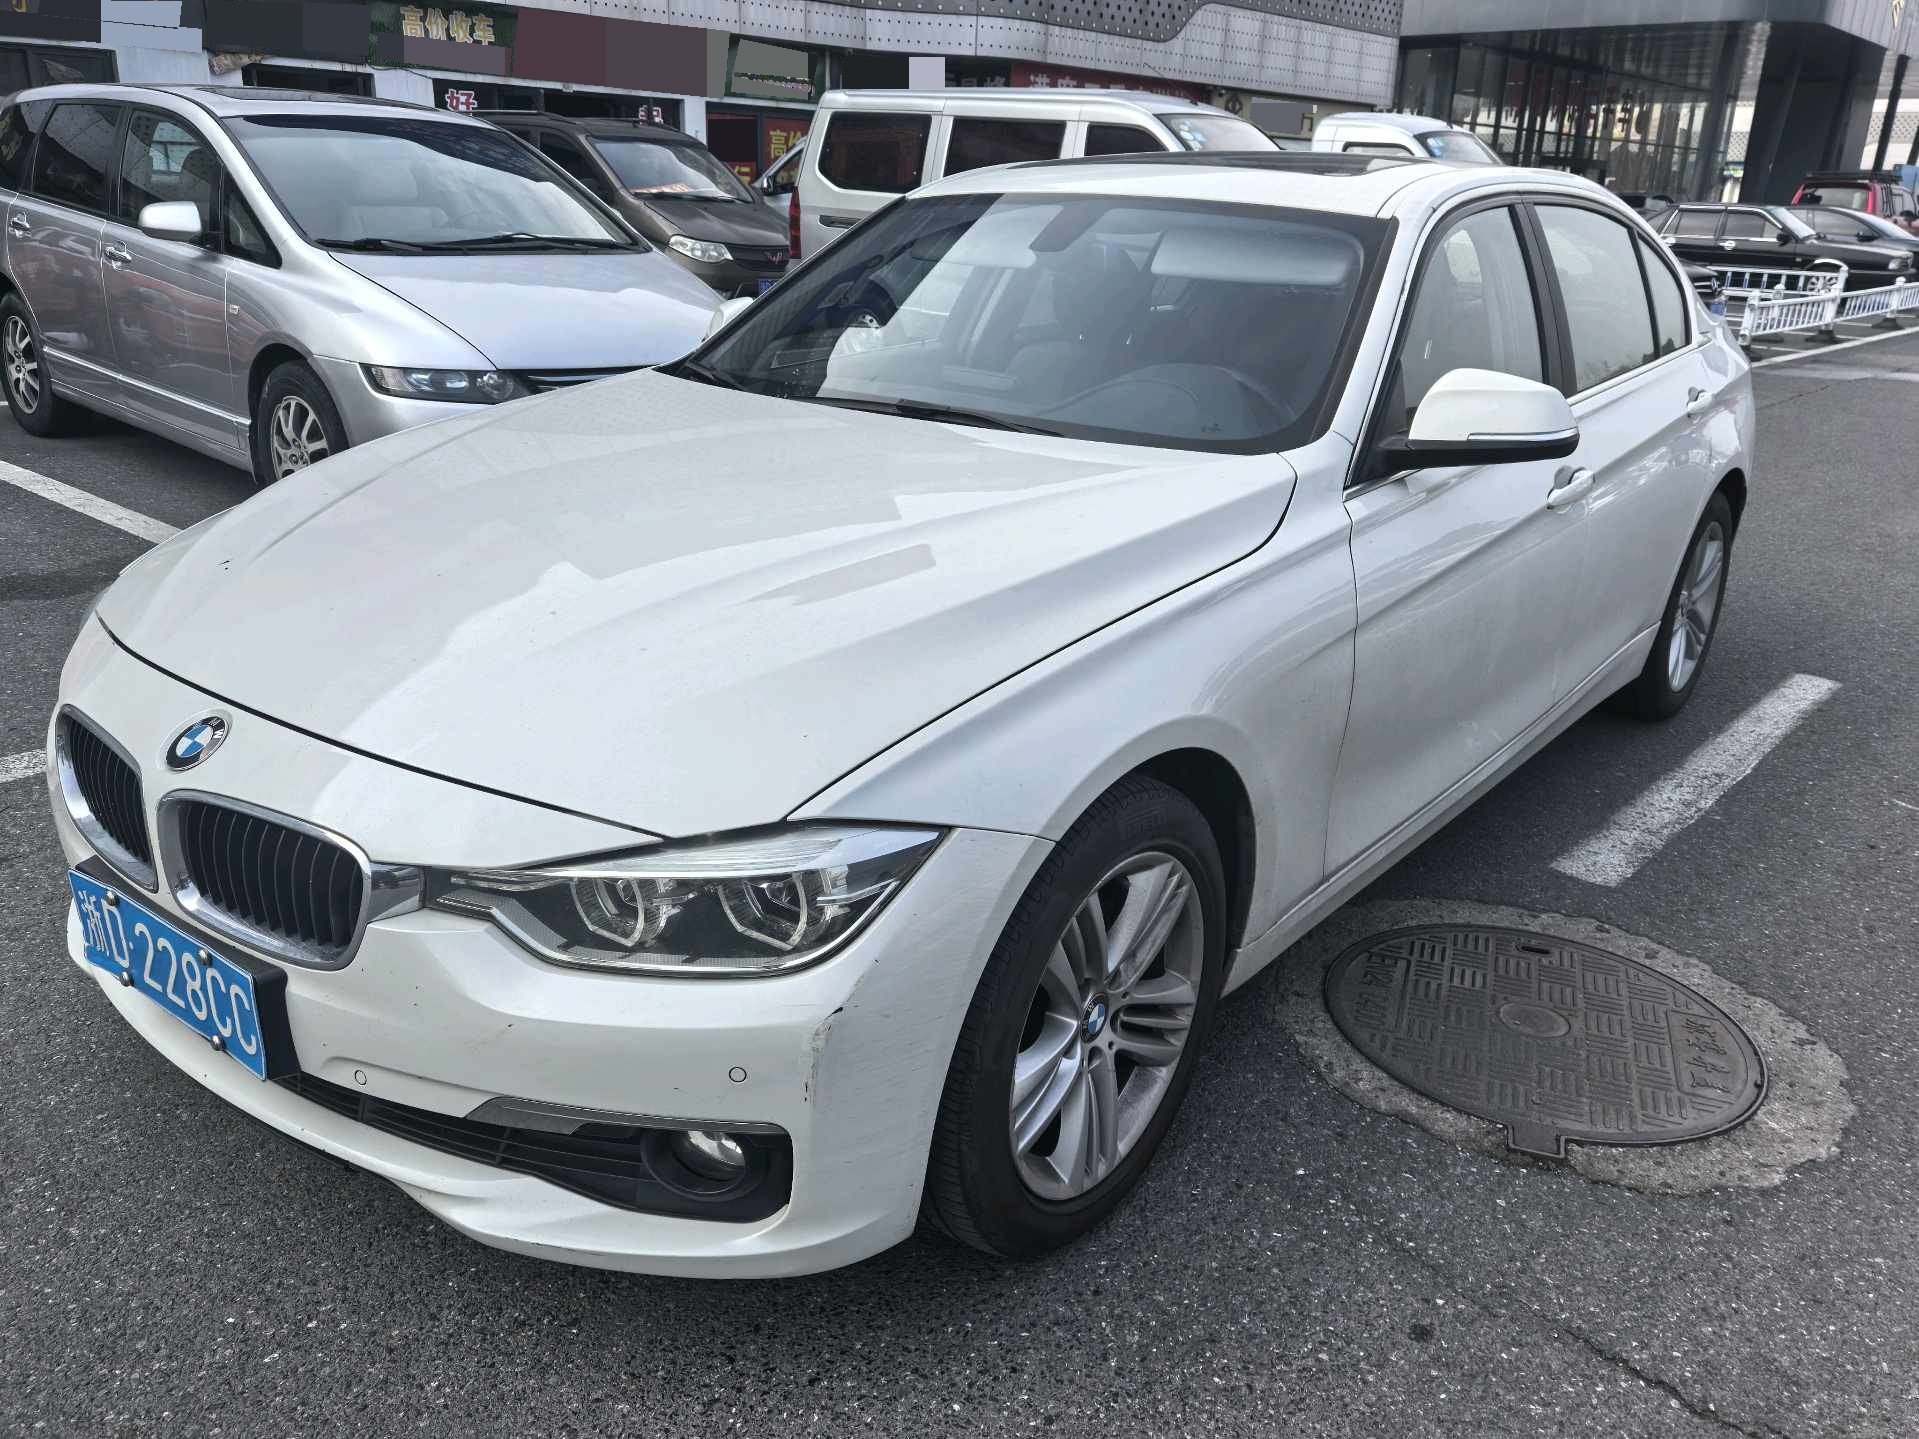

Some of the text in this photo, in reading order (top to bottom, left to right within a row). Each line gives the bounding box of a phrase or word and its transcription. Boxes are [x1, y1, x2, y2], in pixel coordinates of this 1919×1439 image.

[399, 4, 495, 45] 高价收车
[445, 88, 478, 115] 好
